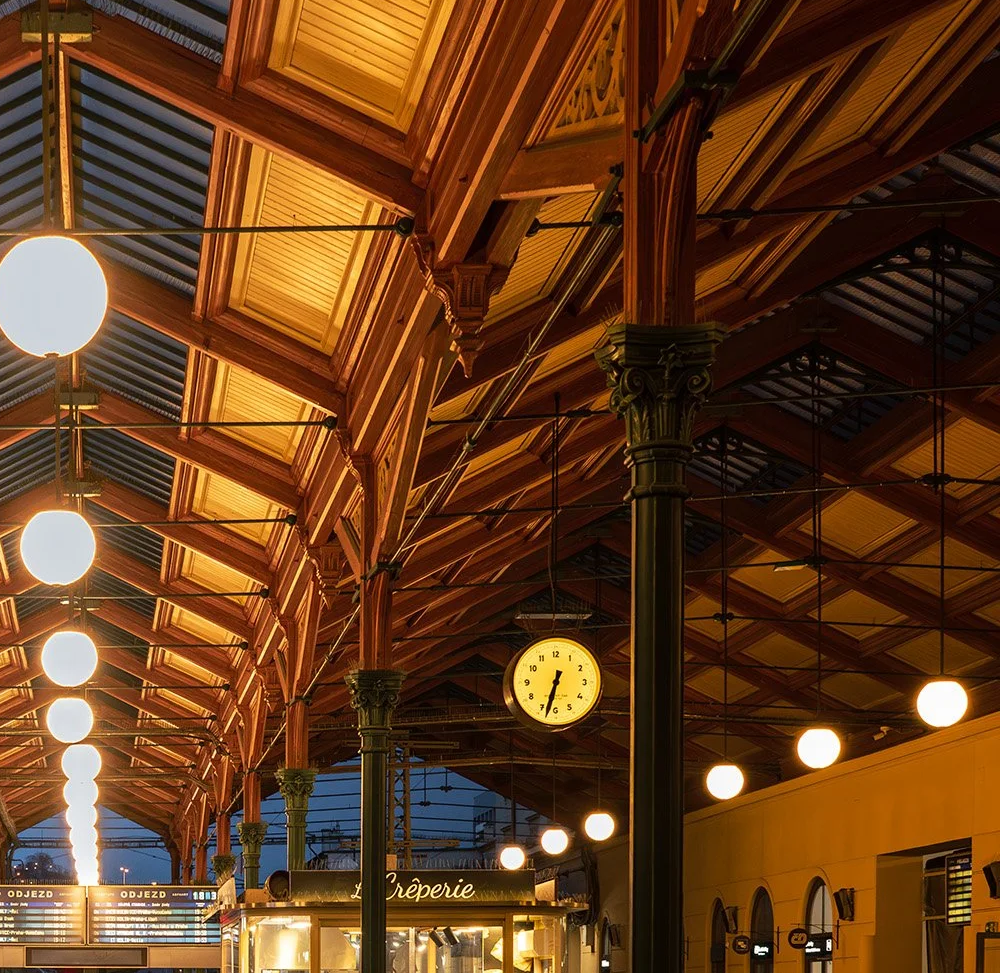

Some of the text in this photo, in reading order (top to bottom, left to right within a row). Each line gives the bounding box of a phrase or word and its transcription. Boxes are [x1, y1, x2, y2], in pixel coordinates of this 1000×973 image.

[386, 872, 476, 902] Crêperie
[8, 890, 53, 898] ODJEZD
[120, 890, 166, 898] ODJEZD
